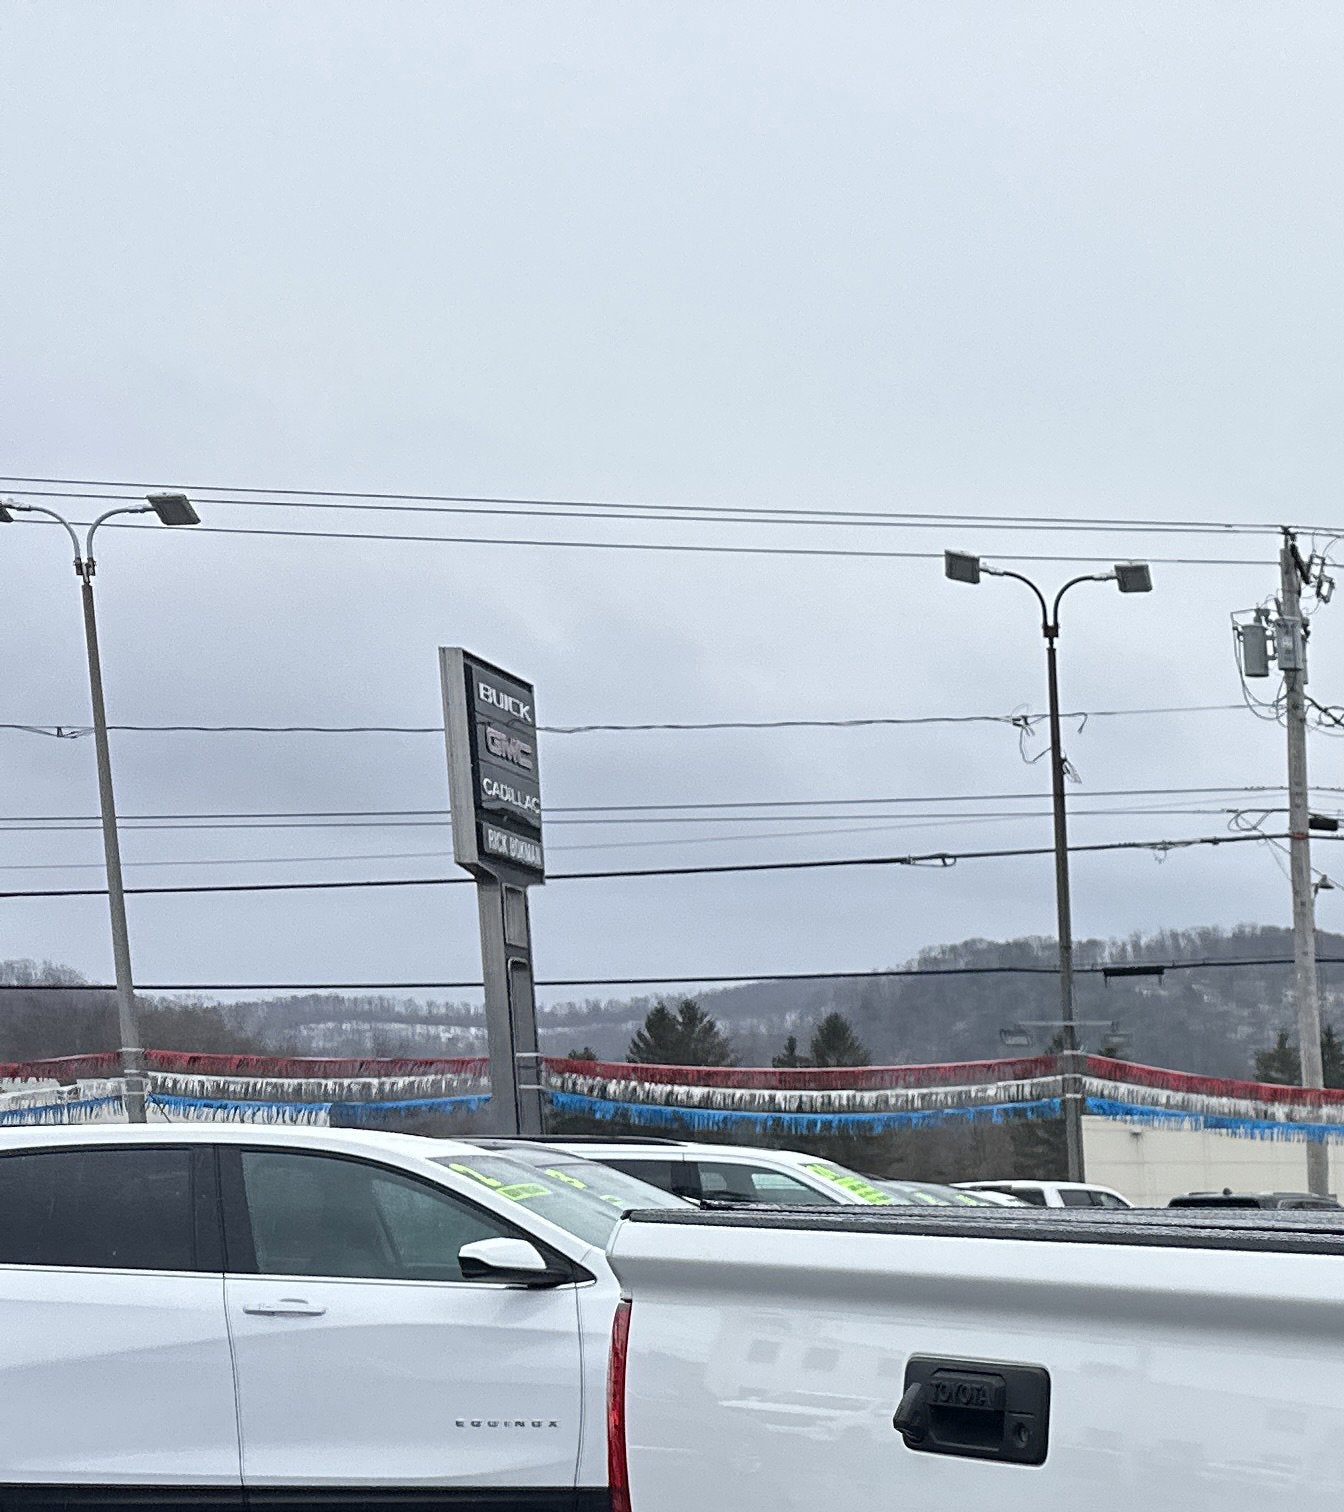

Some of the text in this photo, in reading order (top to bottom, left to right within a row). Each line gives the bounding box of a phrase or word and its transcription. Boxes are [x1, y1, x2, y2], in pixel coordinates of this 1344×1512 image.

[478, 682, 532, 722] BUICK
[485, 726, 532, 770] GMC
[482, 777, 540, 814] CADILLAC
[455, 1420, 558, 1428] EQUINOX
